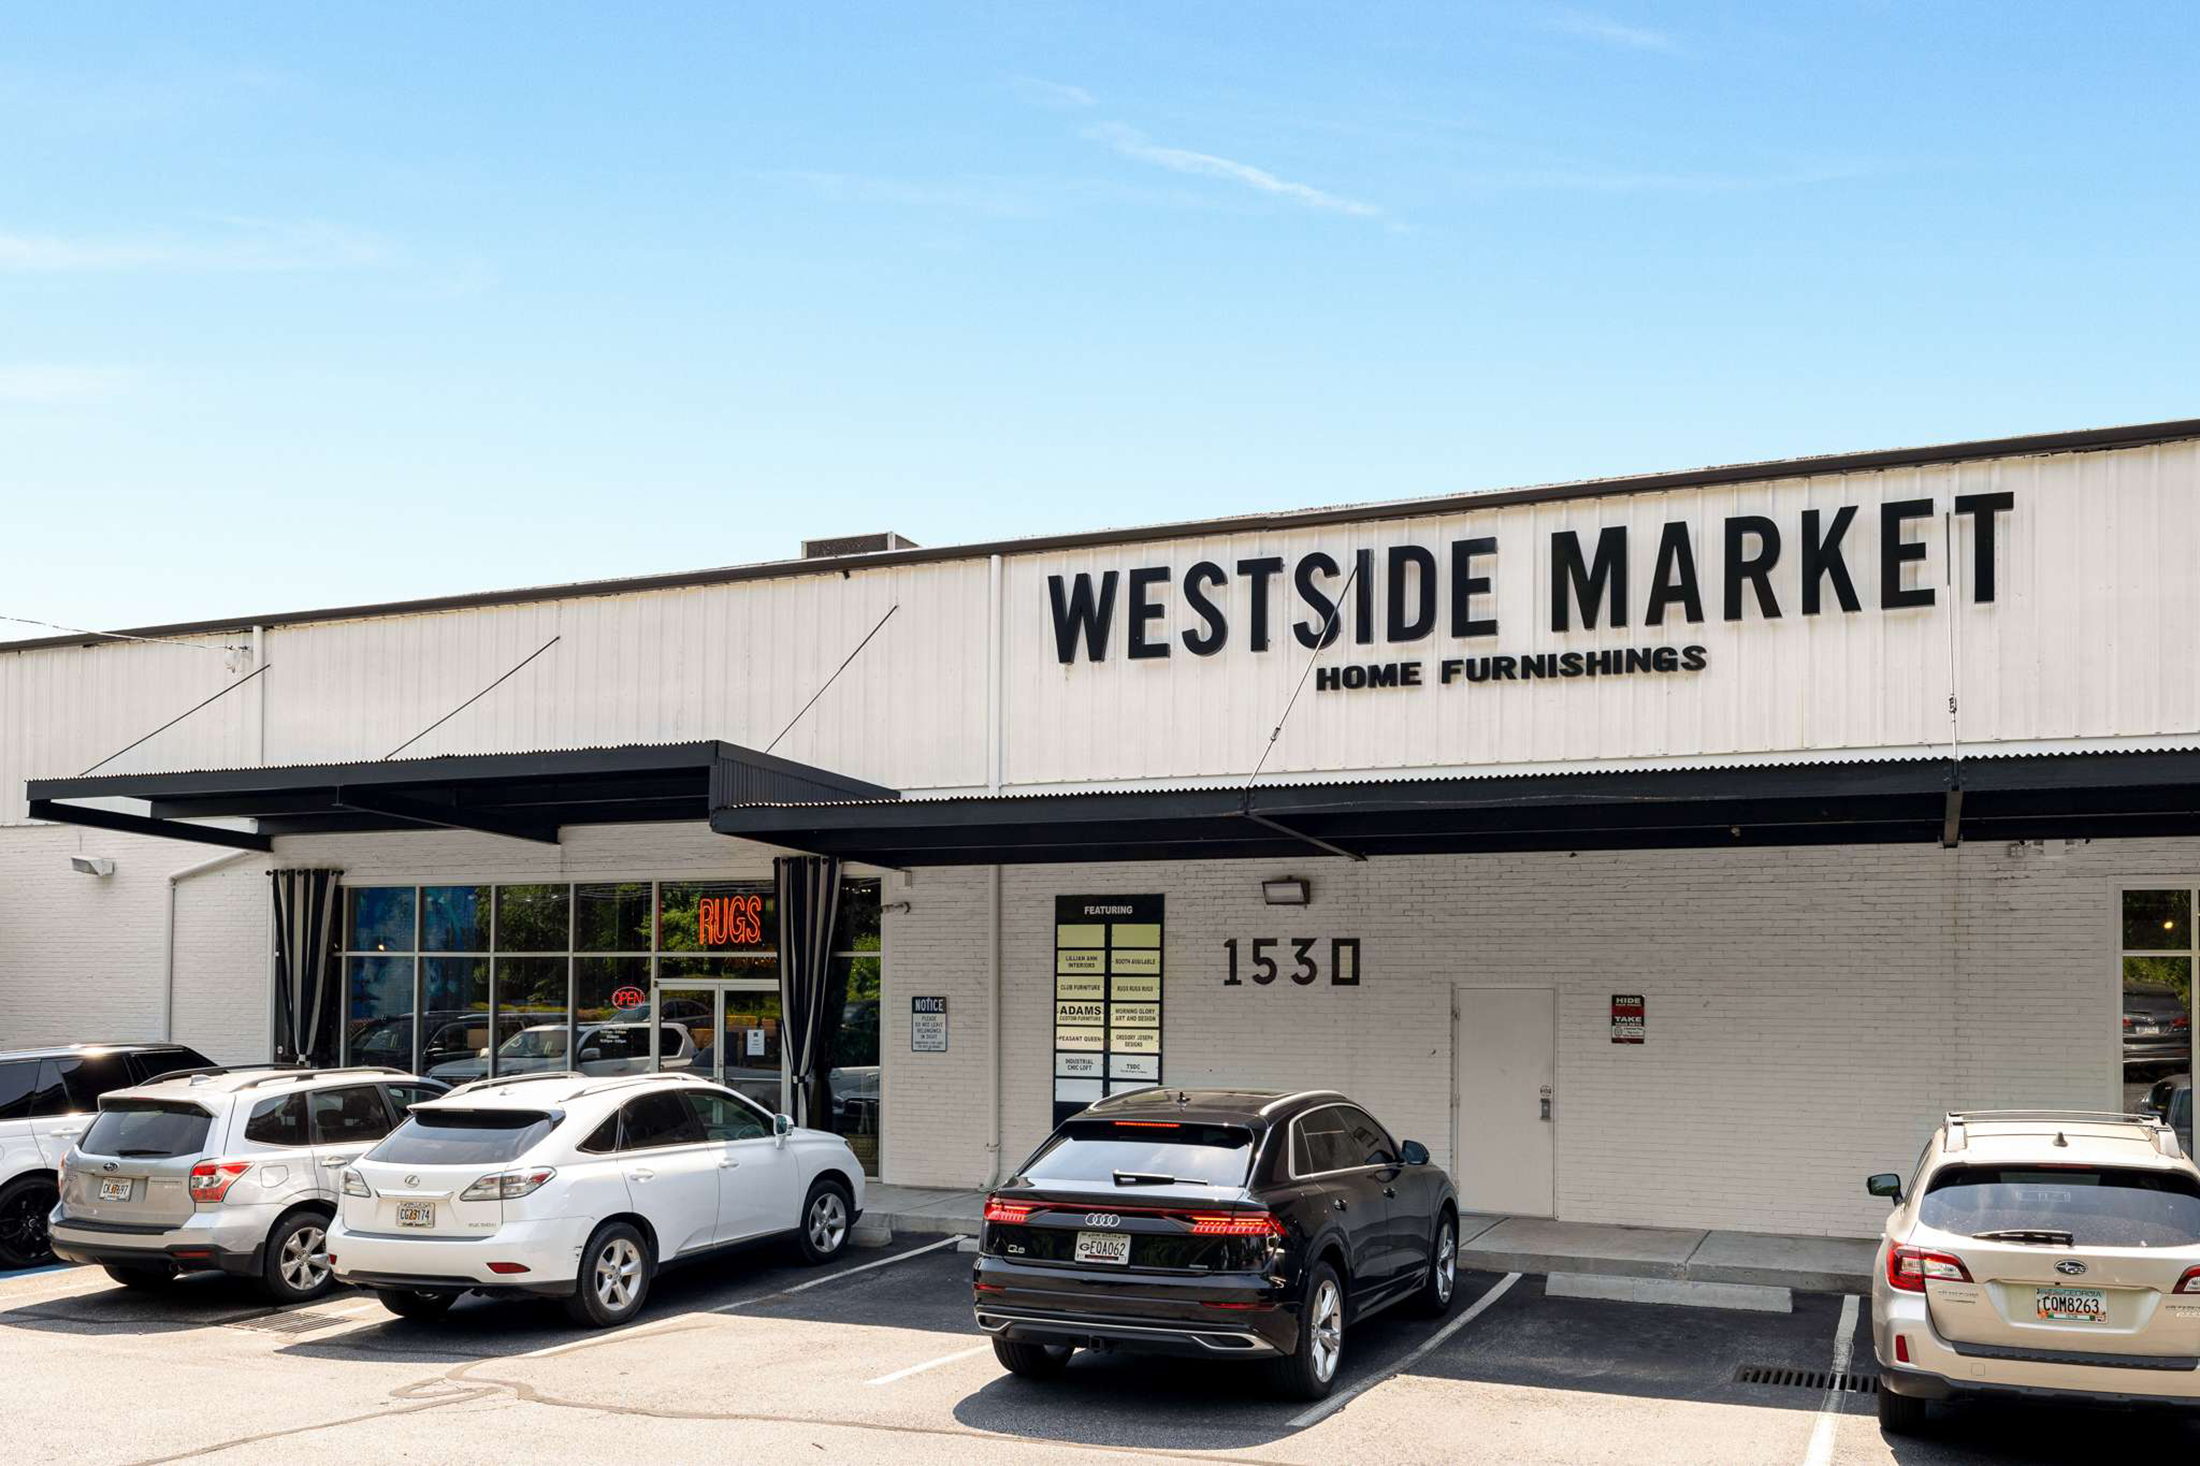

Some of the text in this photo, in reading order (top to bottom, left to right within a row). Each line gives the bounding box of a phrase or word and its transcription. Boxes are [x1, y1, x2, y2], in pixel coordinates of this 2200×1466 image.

[1047, 491, 2014, 664] WESTSIDE MARKET
[1316, 644, 1708, 691] HOME FURNISHINGS
[699, 895, 762, 945] RUGS
[1084, 905, 1133, 915] FEATURING
[1223, 937, 1361, 986] 1530
[614, 991, 643, 1006] OPEN
[915, 999, 944, 1011] NOTICE
[1059, 1005, 1102, 1015] ADAMS
